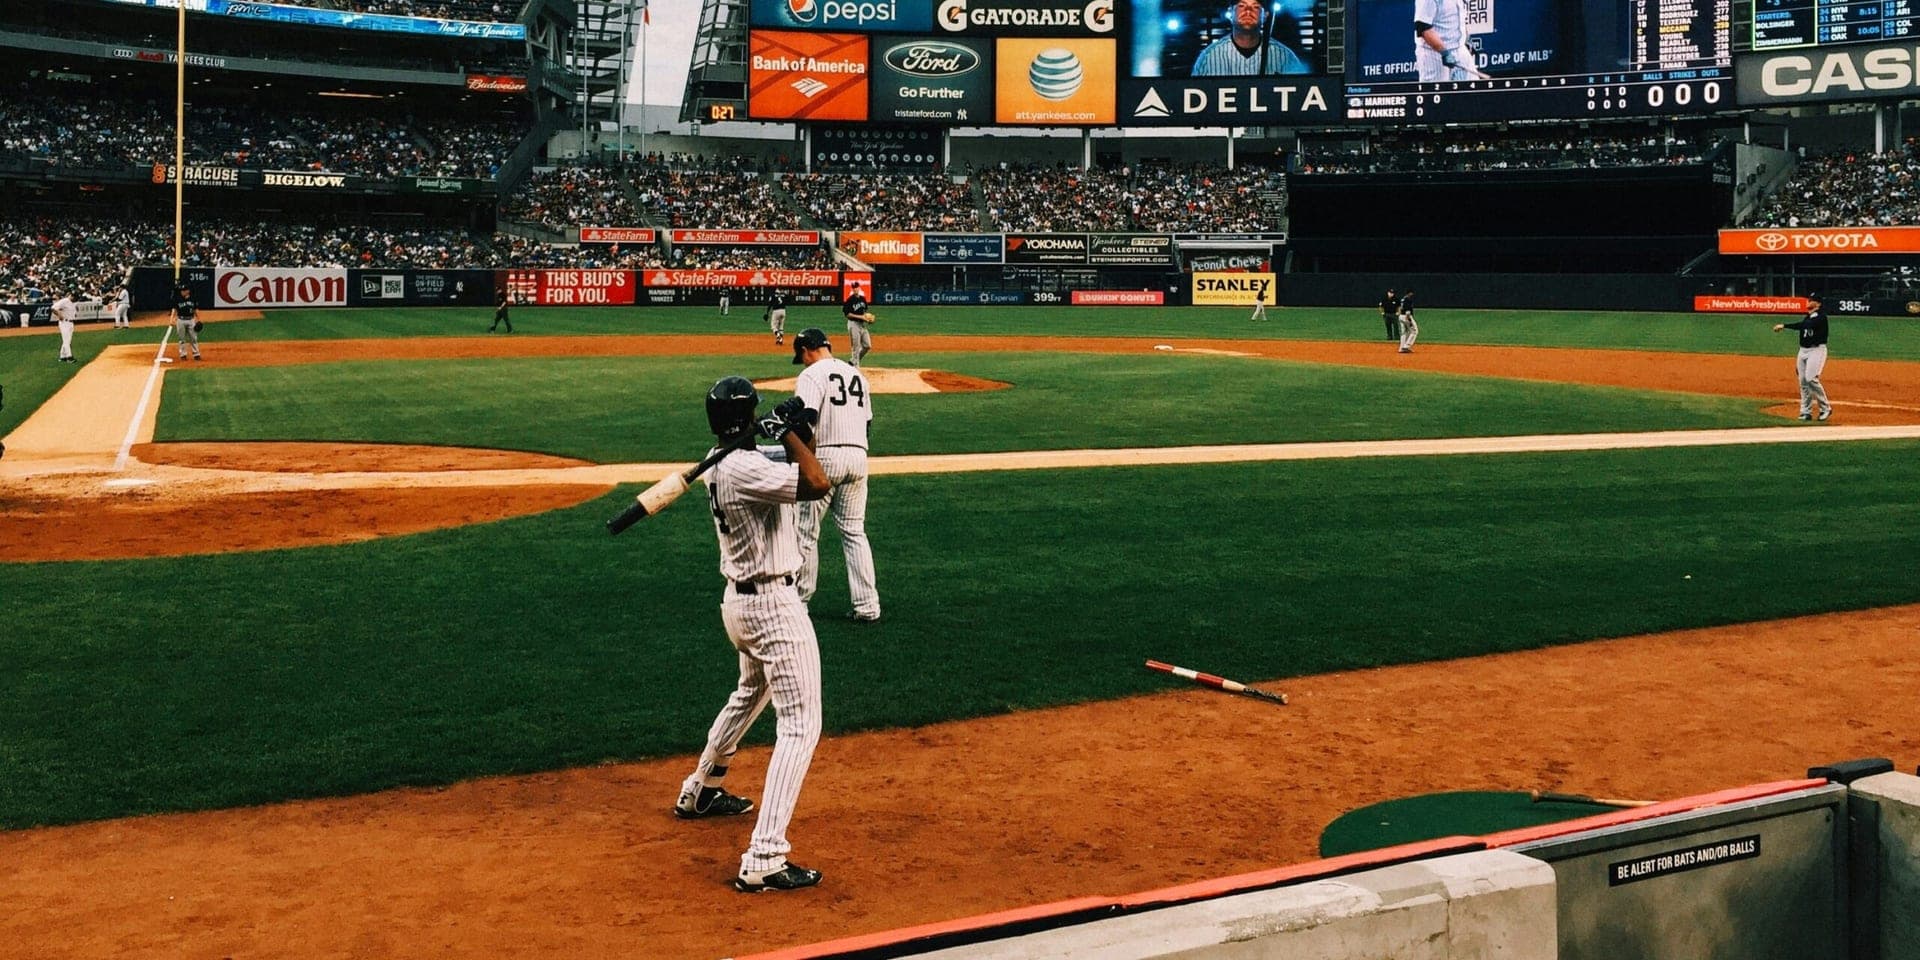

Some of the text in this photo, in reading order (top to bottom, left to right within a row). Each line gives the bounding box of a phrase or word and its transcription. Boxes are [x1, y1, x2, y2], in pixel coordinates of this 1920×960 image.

[823, 0, 896, 25] pepsi
[971, 9, 1080, 26] GATORADE
[1831, 14, 1846, 22] STL
[1896, 8, 1910, 16] ARI
[1831, 33, 1848, 41] OAK
[168, 53, 204, 65] YAKEES
[205, 56, 226, 67] CLUB
[753, 55, 865, 73] Bank of America
[903, 46, 961, 71] Ford
[1491, 54, 1511, 66] CAP
[1513, 52, 1525, 63] OF
[1364, 65, 1380, 76] THE
[1643, 72, 1663, 80] BALLS
[1669, 71, 1696, 79] STRIKES
[1701, 69, 1719, 78] OUTS
[467, 78, 526, 91] Budweiser
[900, 87, 964, 99] Go Further
[1183, 86, 1328, 113] DELTA
[1365, 86, 1626, 106] MARINERS 0 0 0 1 0
[1648, 82, 1720, 106] 0 0 0
[895, 109, 952, 118] tristateford.com
[1016, 111, 1096, 122] att.yankees.com
[1366, 99, 1626, 119] YANKEES 0 0 0 0
[167, 166, 239, 181] SRACUSE
[1025, 239, 1085, 249] YOKOHAMA
[1791, 233, 1878, 248] TOYOTA
[861, 240, 920, 257] DraftKings
[1190, 256, 1263, 271] Peanut Chews
[546, 271, 625, 287] THIS BUD'S
[1197, 279, 1270, 291] STANLEY
[217, 271, 345, 304] Canon
[546, 288, 610, 303] FOR YOU.
[990, 294, 1018, 302] Experian
[829, 373, 864, 407] 34
[1618, 840, 1755, 879] BE ALERT FOR BATS AND/OR BALLS
